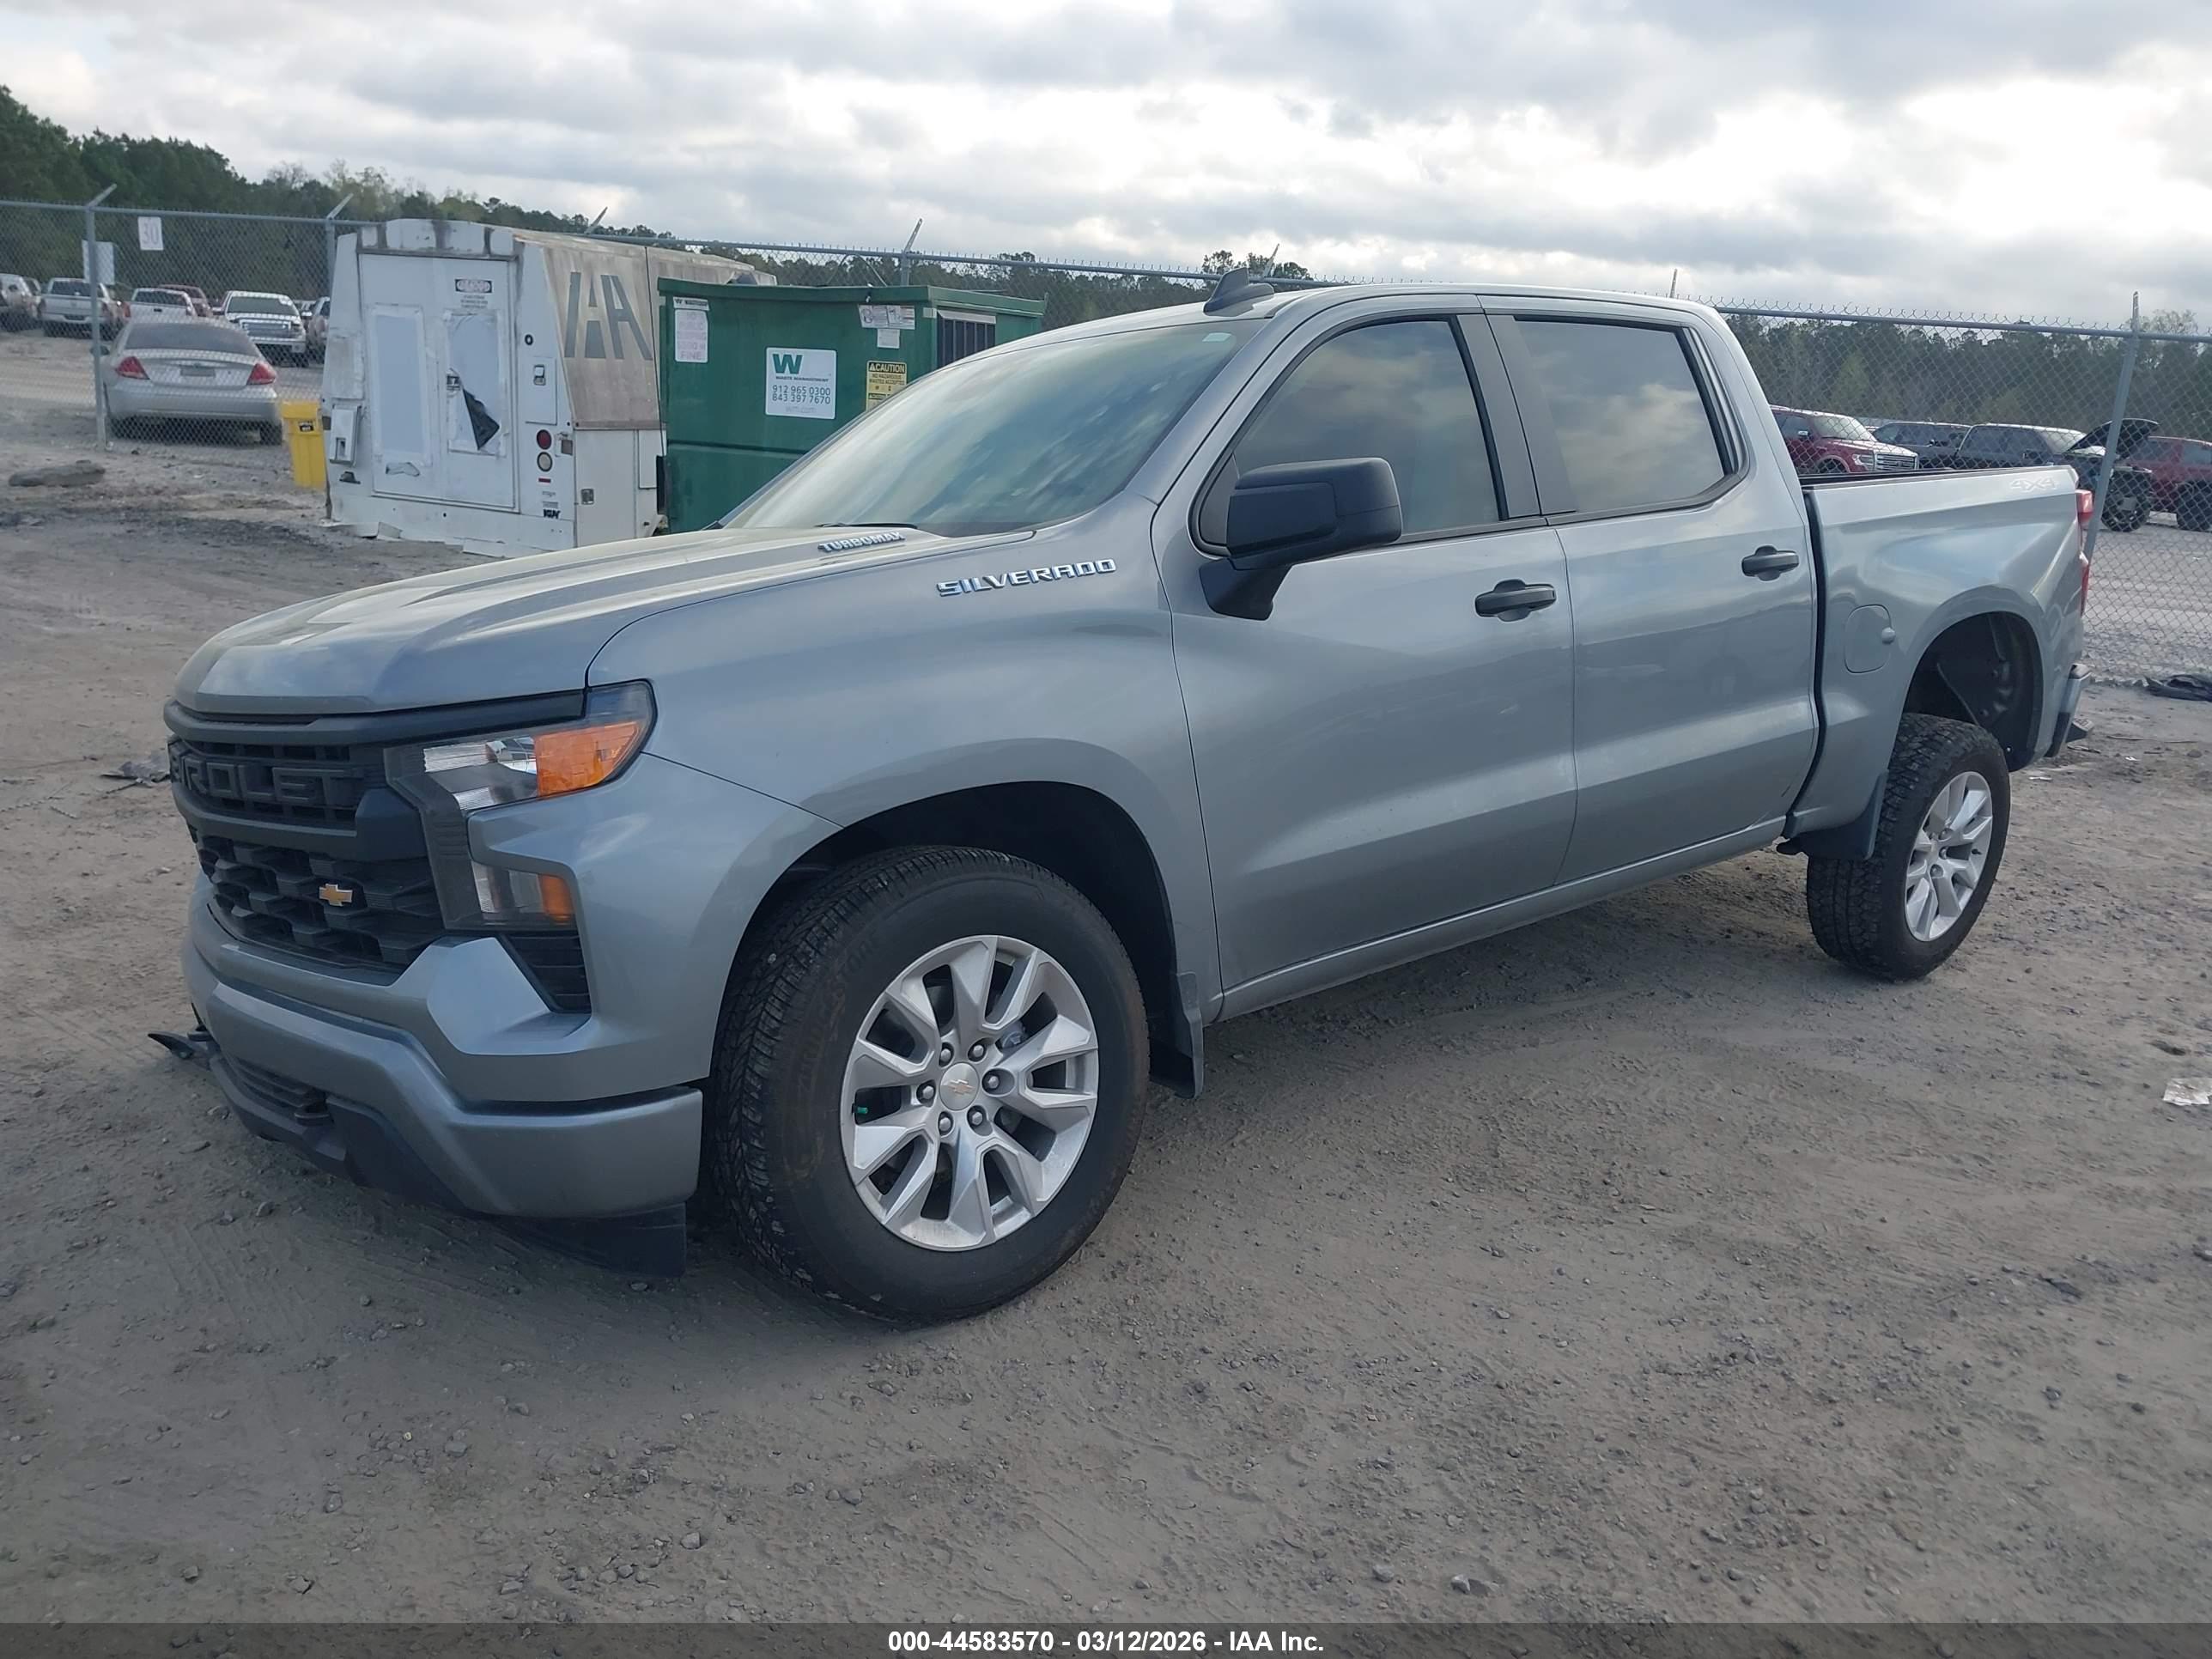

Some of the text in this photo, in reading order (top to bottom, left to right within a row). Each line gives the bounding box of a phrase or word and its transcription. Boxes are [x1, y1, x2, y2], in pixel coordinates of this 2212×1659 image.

[773, 353, 802, 374] W
[876, 362, 905, 373] CAUTION
[791, 386, 806, 394] 965
[809, 386, 830, 395] 0300
[772, 393, 830, 404] 843 397 7670
[817, 532, 905, 552] TURBOMAX
[937, 558, 1116, 597] SILVERADO
